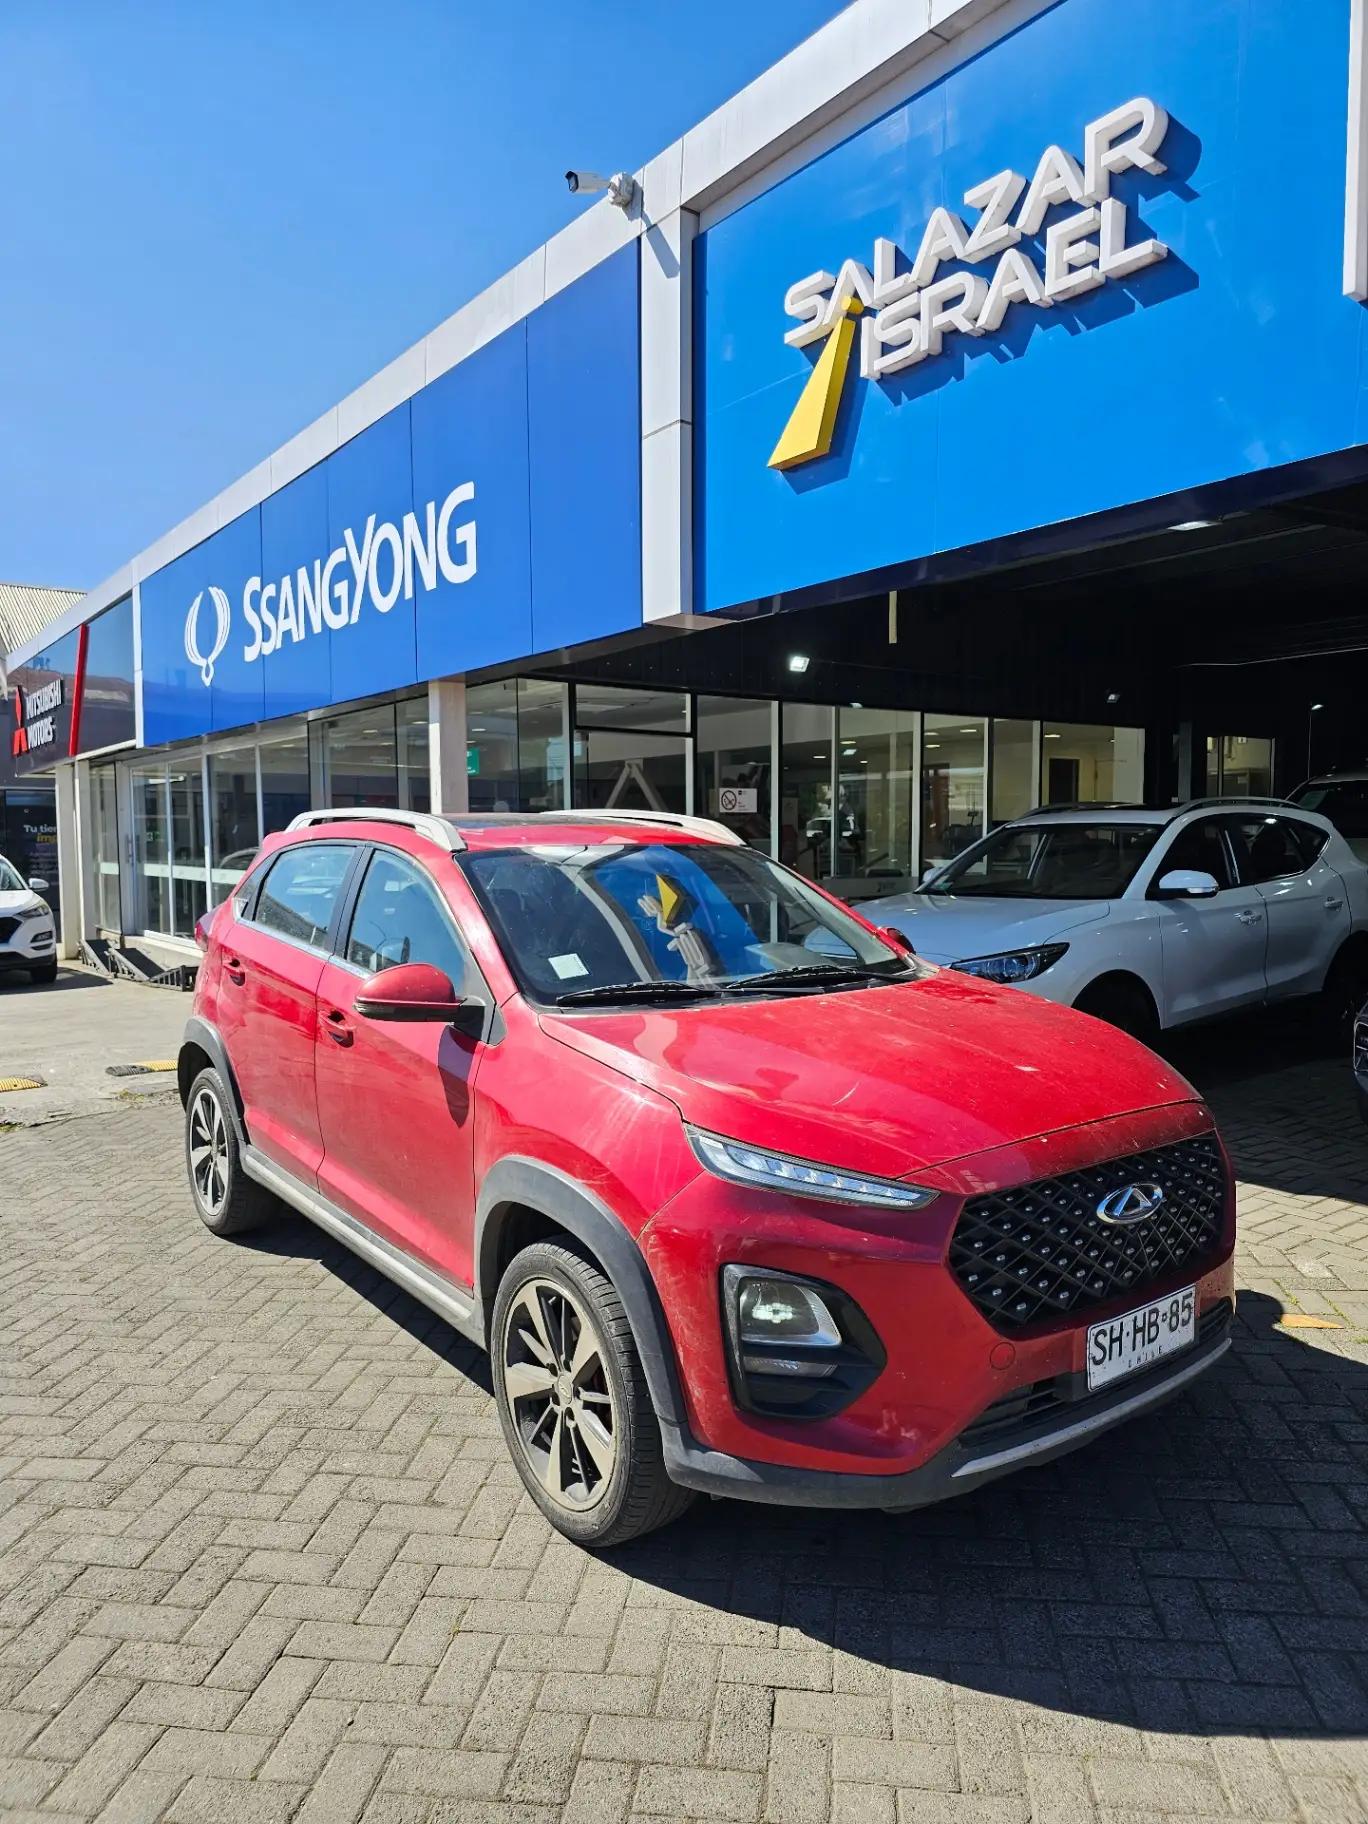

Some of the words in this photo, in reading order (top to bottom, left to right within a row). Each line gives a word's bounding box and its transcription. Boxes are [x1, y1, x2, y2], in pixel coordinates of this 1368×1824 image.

[783, 96, 1169, 349] SALAZAR
[859, 196, 1169, 379] ISRAEL
[242, 481, 478, 663] SSANGYONG
[25, 679, 62, 720] MITSUBISHI
[27, 715, 54, 749] MOTORS
[23, 824, 38, 833] Tu
